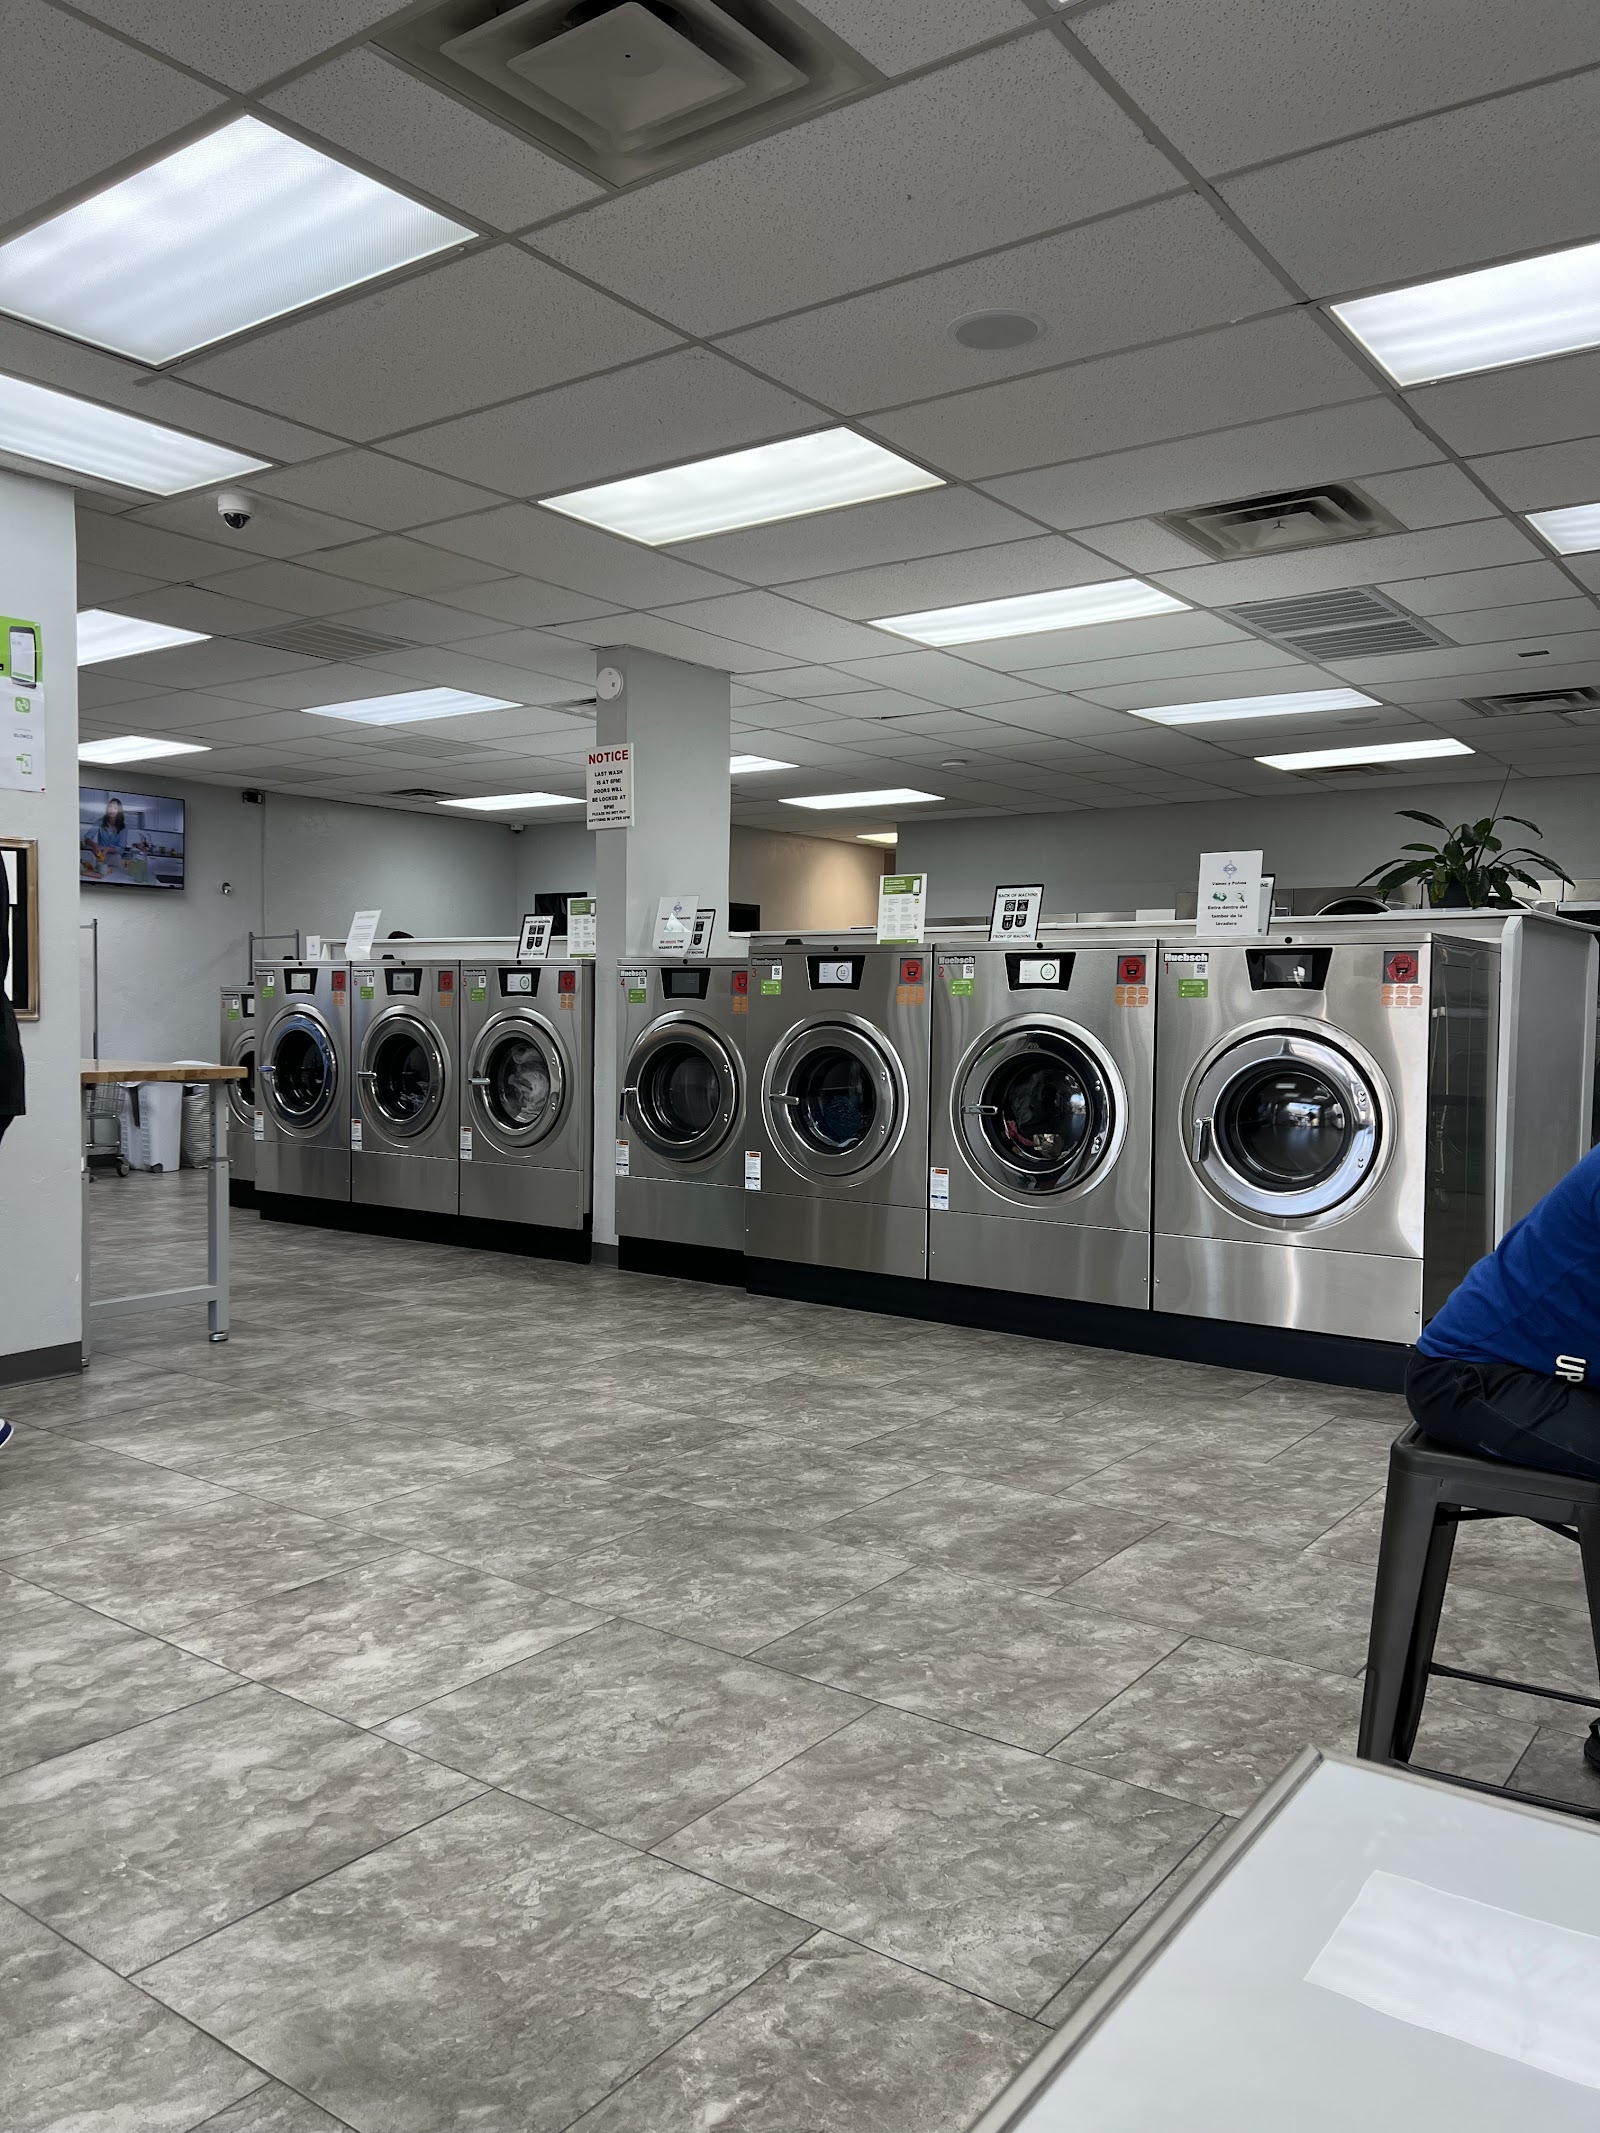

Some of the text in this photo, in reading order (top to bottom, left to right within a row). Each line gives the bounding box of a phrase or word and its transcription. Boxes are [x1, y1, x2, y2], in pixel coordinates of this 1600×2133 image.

[588, 750, 629, 764] NOTICE
[1164, 954, 1208, 962] Huebsch
[752, 968, 756, 977] 3
[939, 966, 944, 978] 2
[1165, 963, 1169, 974] 1
[354, 978, 357, 986] 6
[464, 978, 467, 986] 5
[620, 978, 625, 987] 4
[1555, 1355, 1586, 1382] UP
